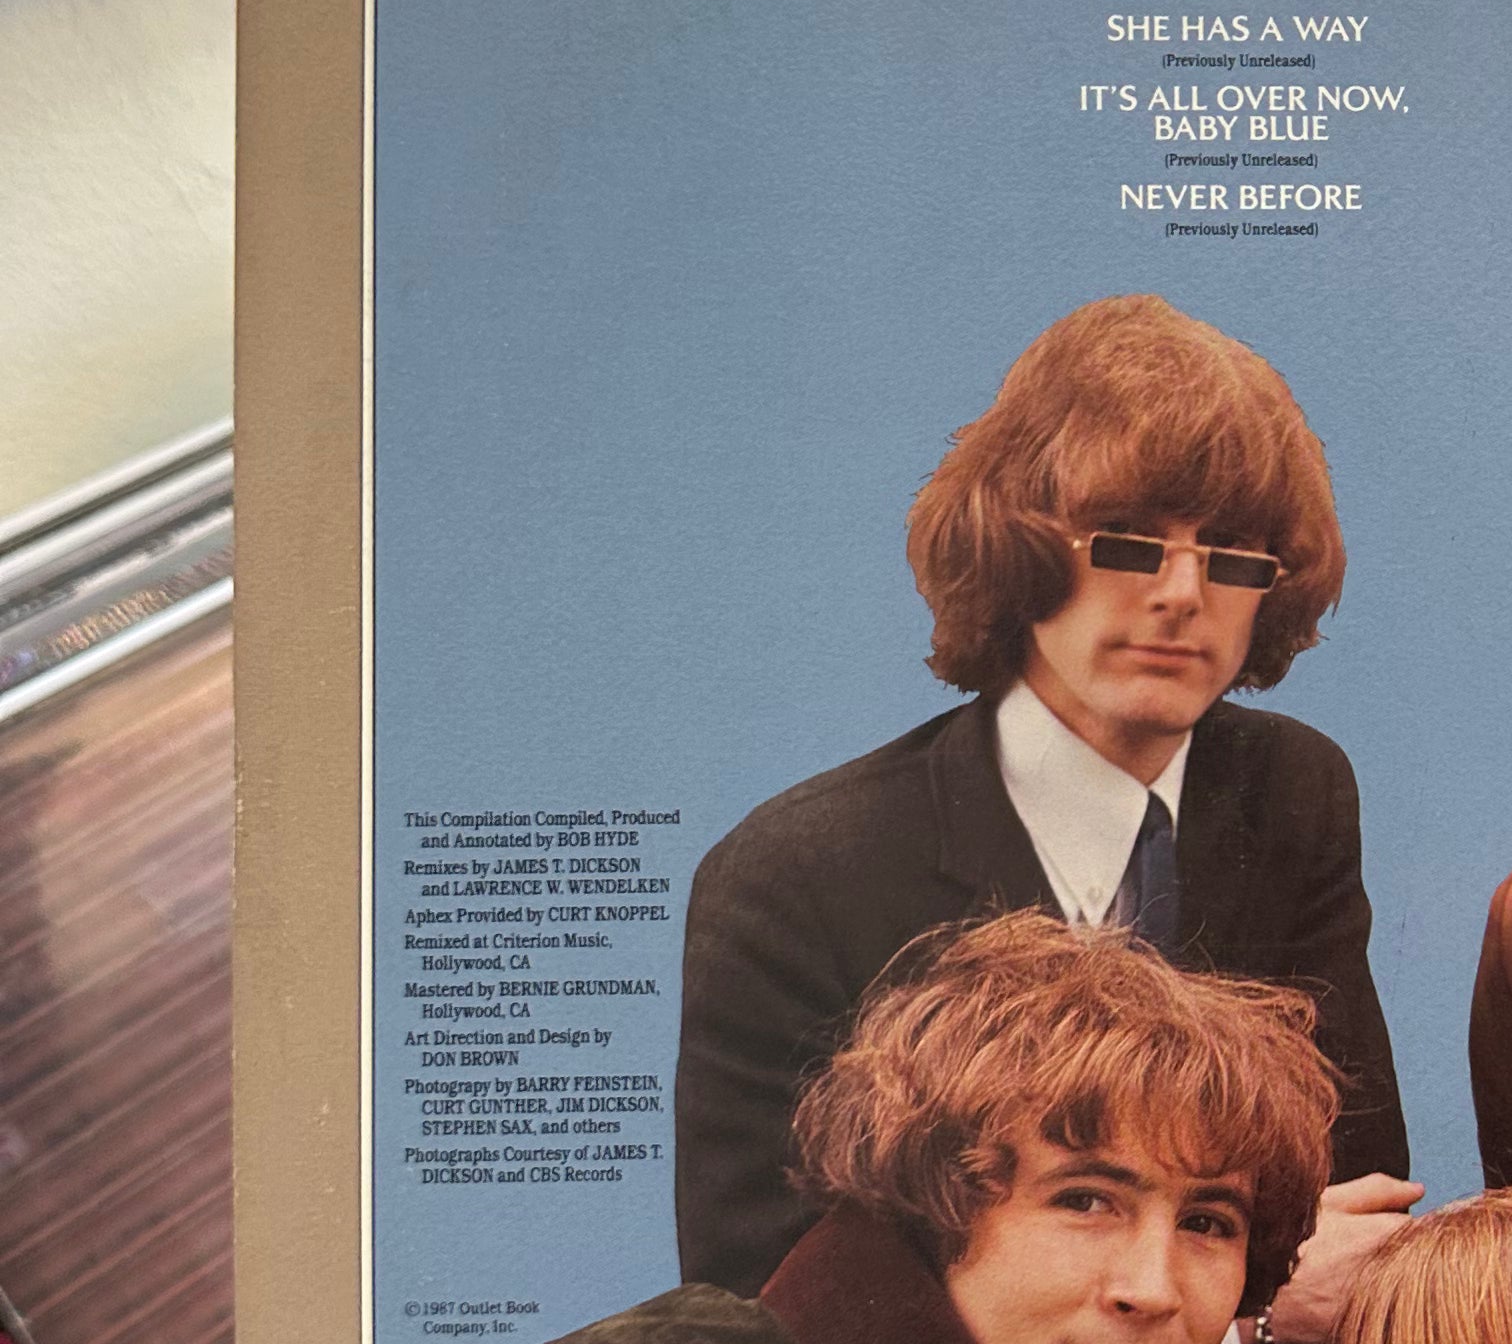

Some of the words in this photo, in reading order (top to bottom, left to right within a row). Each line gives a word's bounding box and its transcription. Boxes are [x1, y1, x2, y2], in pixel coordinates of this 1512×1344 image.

[1107, 14, 1171, 42] SHE
[1181, 15, 1250, 42] HAS
[1259, 16, 1284, 42] A
[1292, 15, 1369, 42] WAY
[1162, 53, 1237, 71] (Previously
[1239, 53, 1316, 70] Unreleased)
[1080, 84, 1139, 113] IT'S
[1148, 85, 1208, 112] ALL
[1216, 85, 1310, 112] OVER
[1316, 85, 1411, 116] NOW,
[1154, 115, 1239, 141] BABY
[1249, 115, 1330, 141] BLUE
[1164, 152, 1239, 171] (Previously
[1241, 152, 1318, 169] Unreleased)
[1121, 184, 1229, 210] NEVER
[1239, 184, 1363, 211] BEFORE
[1165, 222, 1239, 240] (Previously
[1241, 222, 1319, 238] Unreleased)
[403, 811, 438, 828] This
[440, 810, 532, 831] Compilation
[534, 809, 608, 830] Compiled,
[611, 809, 681, 825] Produced
[420, 832, 450, 849] and
[453, 832, 532, 849] Annotated
[535, 831, 554, 851] by
[557, 831, 591, 847] BOB
[594, 830, 639, 847] HYDE
[403, 859, 469, 876] Remixes
[471, 859, 490, 879] by
[493, 857, 549, 875] JAMES
[551, 858, 566, 874] T.
[568, 857, 641, 874] DICKSON
[421, 880, 450, 897] and
[453, 879, 543, 897] LAWRENCE
[546, 879, 564, 895] W.
[567, 878, 670, 895] WENDELKEN
[404, 981, 474, 998] Mastered
[477, 981, 495, 1001] by
[498, 980, 560, 997] BERNIE
[562, 979, 660, 996] GRUNDMAN,
[421, 1051, 456, 1067] DON
[460, 1050, 519, 1067] BROWN
[421, 1097, 466, 1117] CURT
[468, 1098, 552, 1115] GUNTHER,
[555, 1097, 585, 1114] JIM
[588, 1096, 664, 1113] DICKSON,
